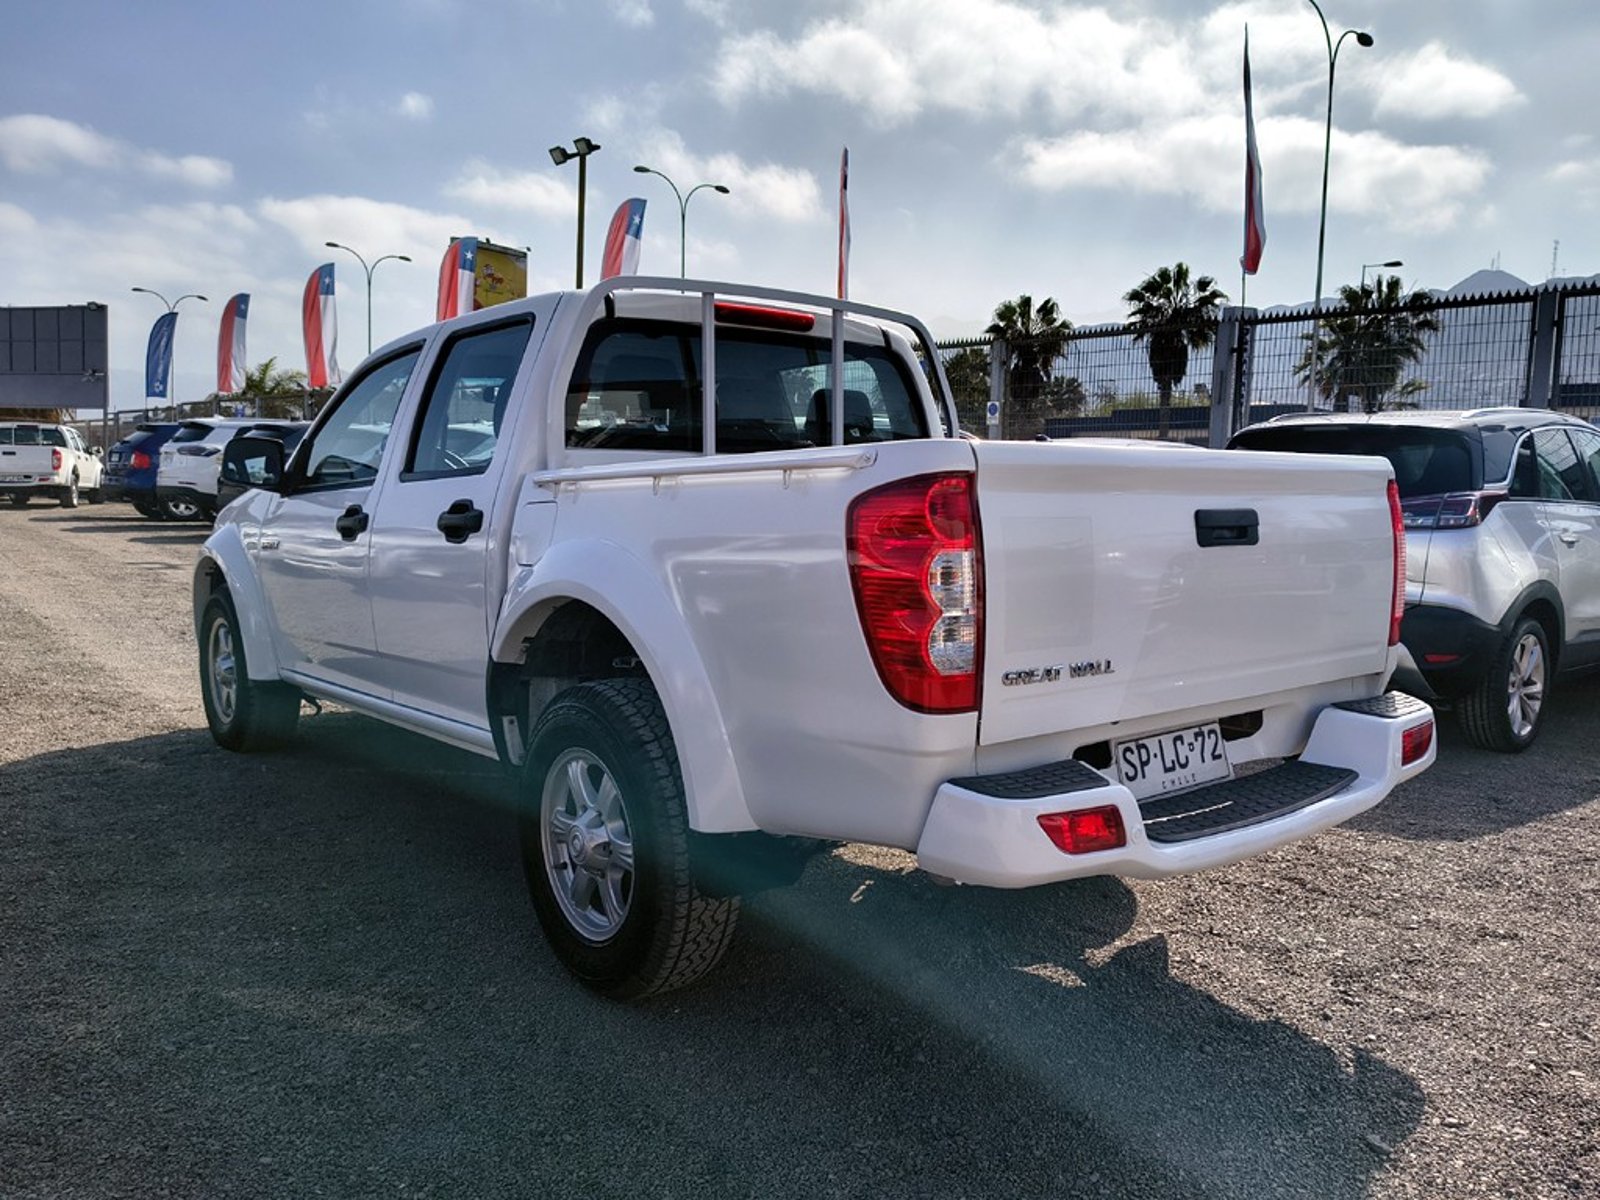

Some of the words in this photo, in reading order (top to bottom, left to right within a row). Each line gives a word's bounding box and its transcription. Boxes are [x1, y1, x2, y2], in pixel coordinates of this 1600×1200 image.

[1001, 663, 1064, 686] GREAT
[1069, 658, 1115, 679] WALL
[1162, 772, 1197, 789] CHILE
